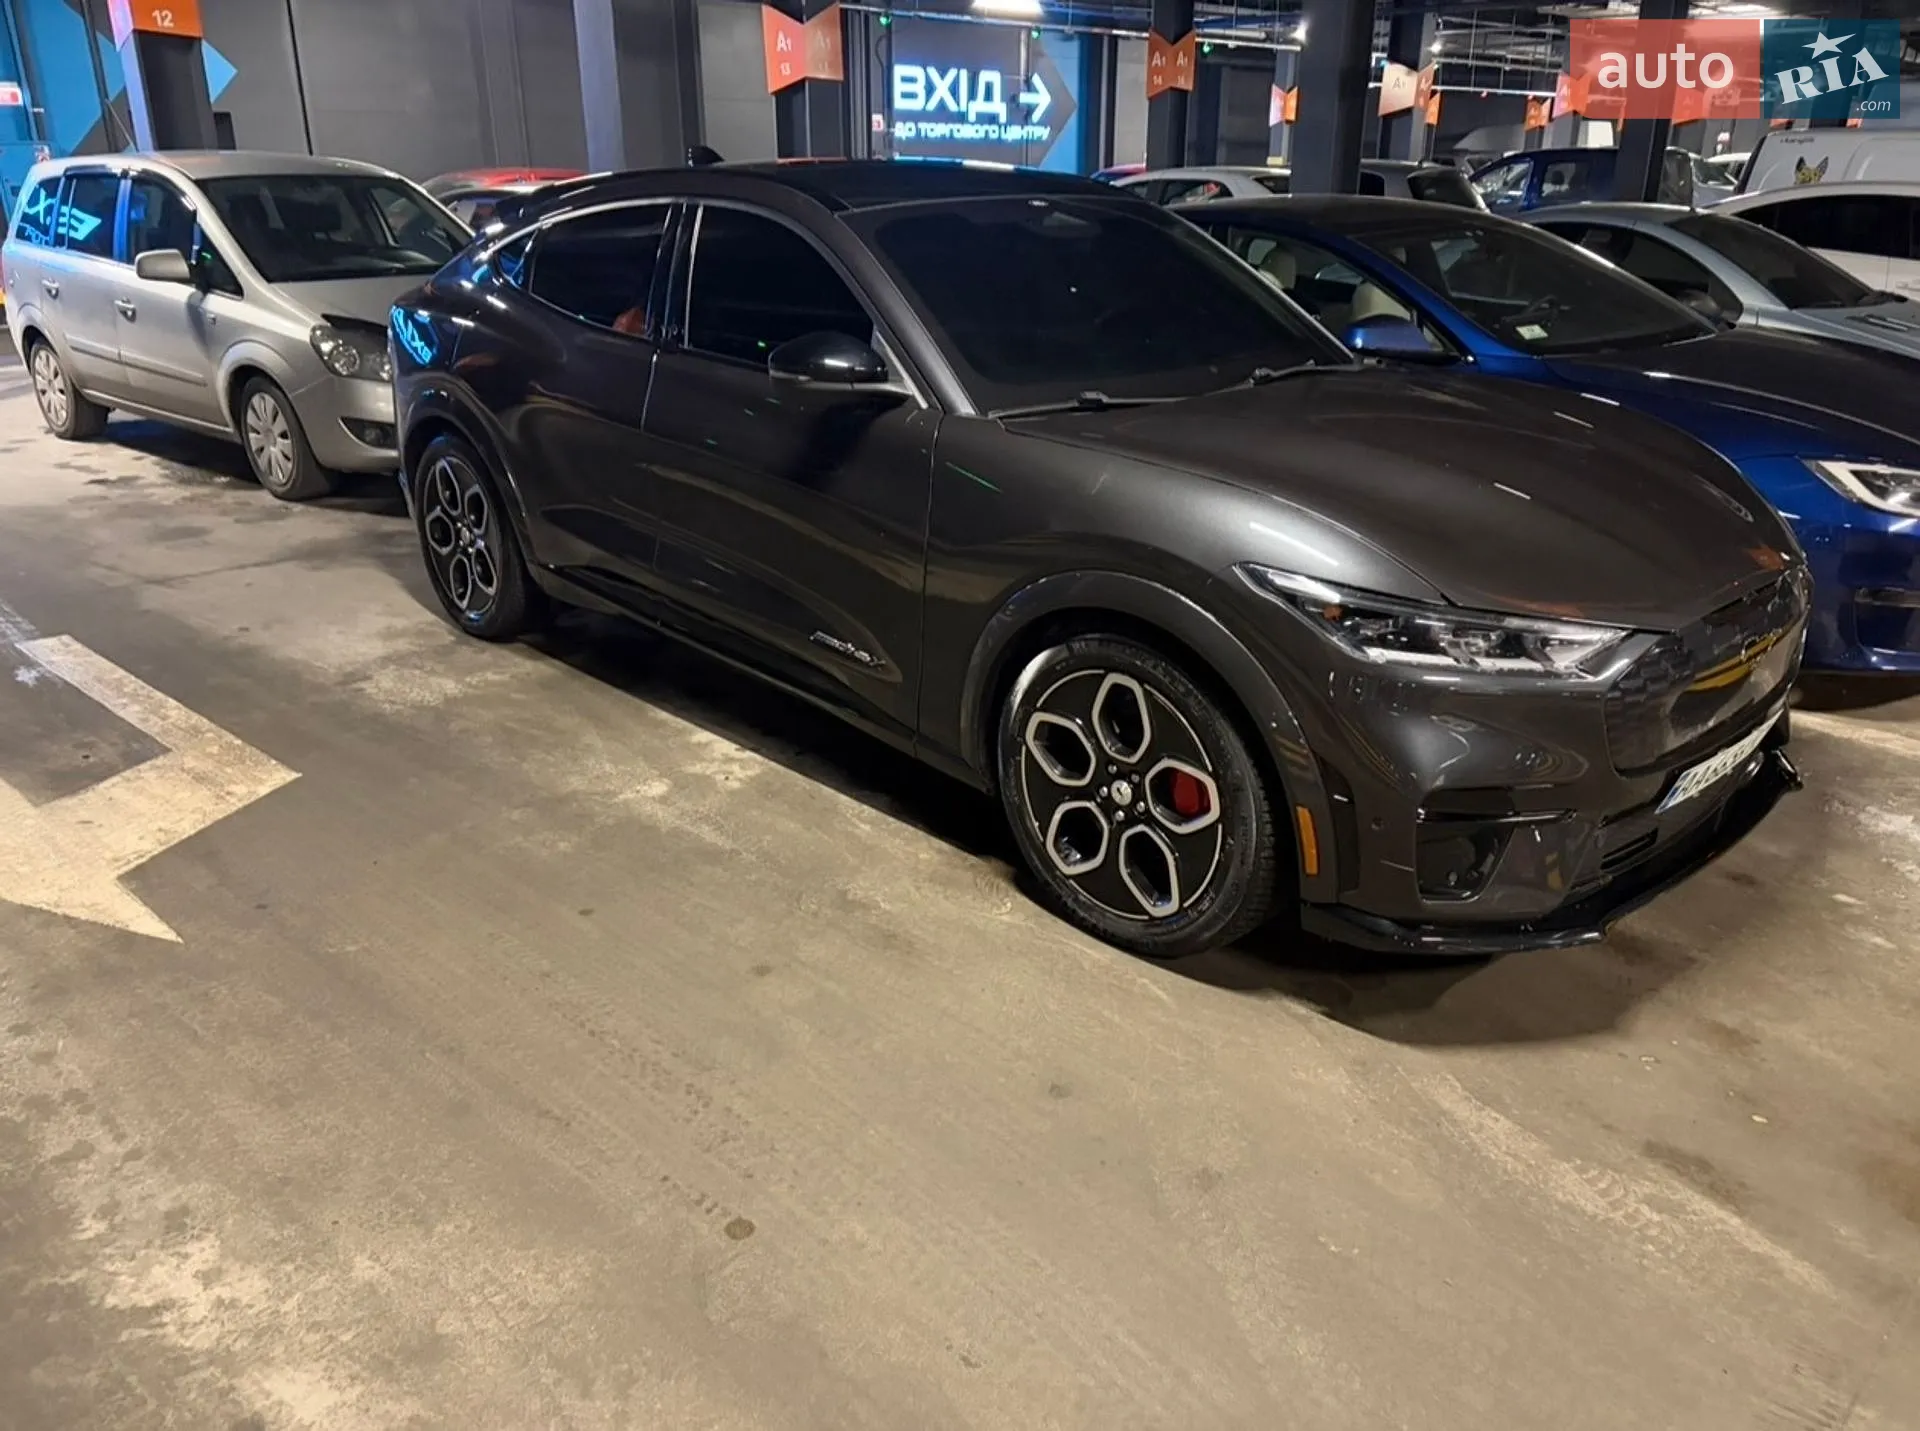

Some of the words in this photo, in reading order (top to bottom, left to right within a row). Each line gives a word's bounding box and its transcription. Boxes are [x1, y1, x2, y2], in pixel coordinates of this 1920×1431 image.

[151, 9, 175, 28] 12
[776, 29, 793, 52] A1
[893, 64, 1007, 124] ВХІД
[894, 121, 917, 140] ДО
[918, 121, 1001, 139] ТОРГОВОГО
